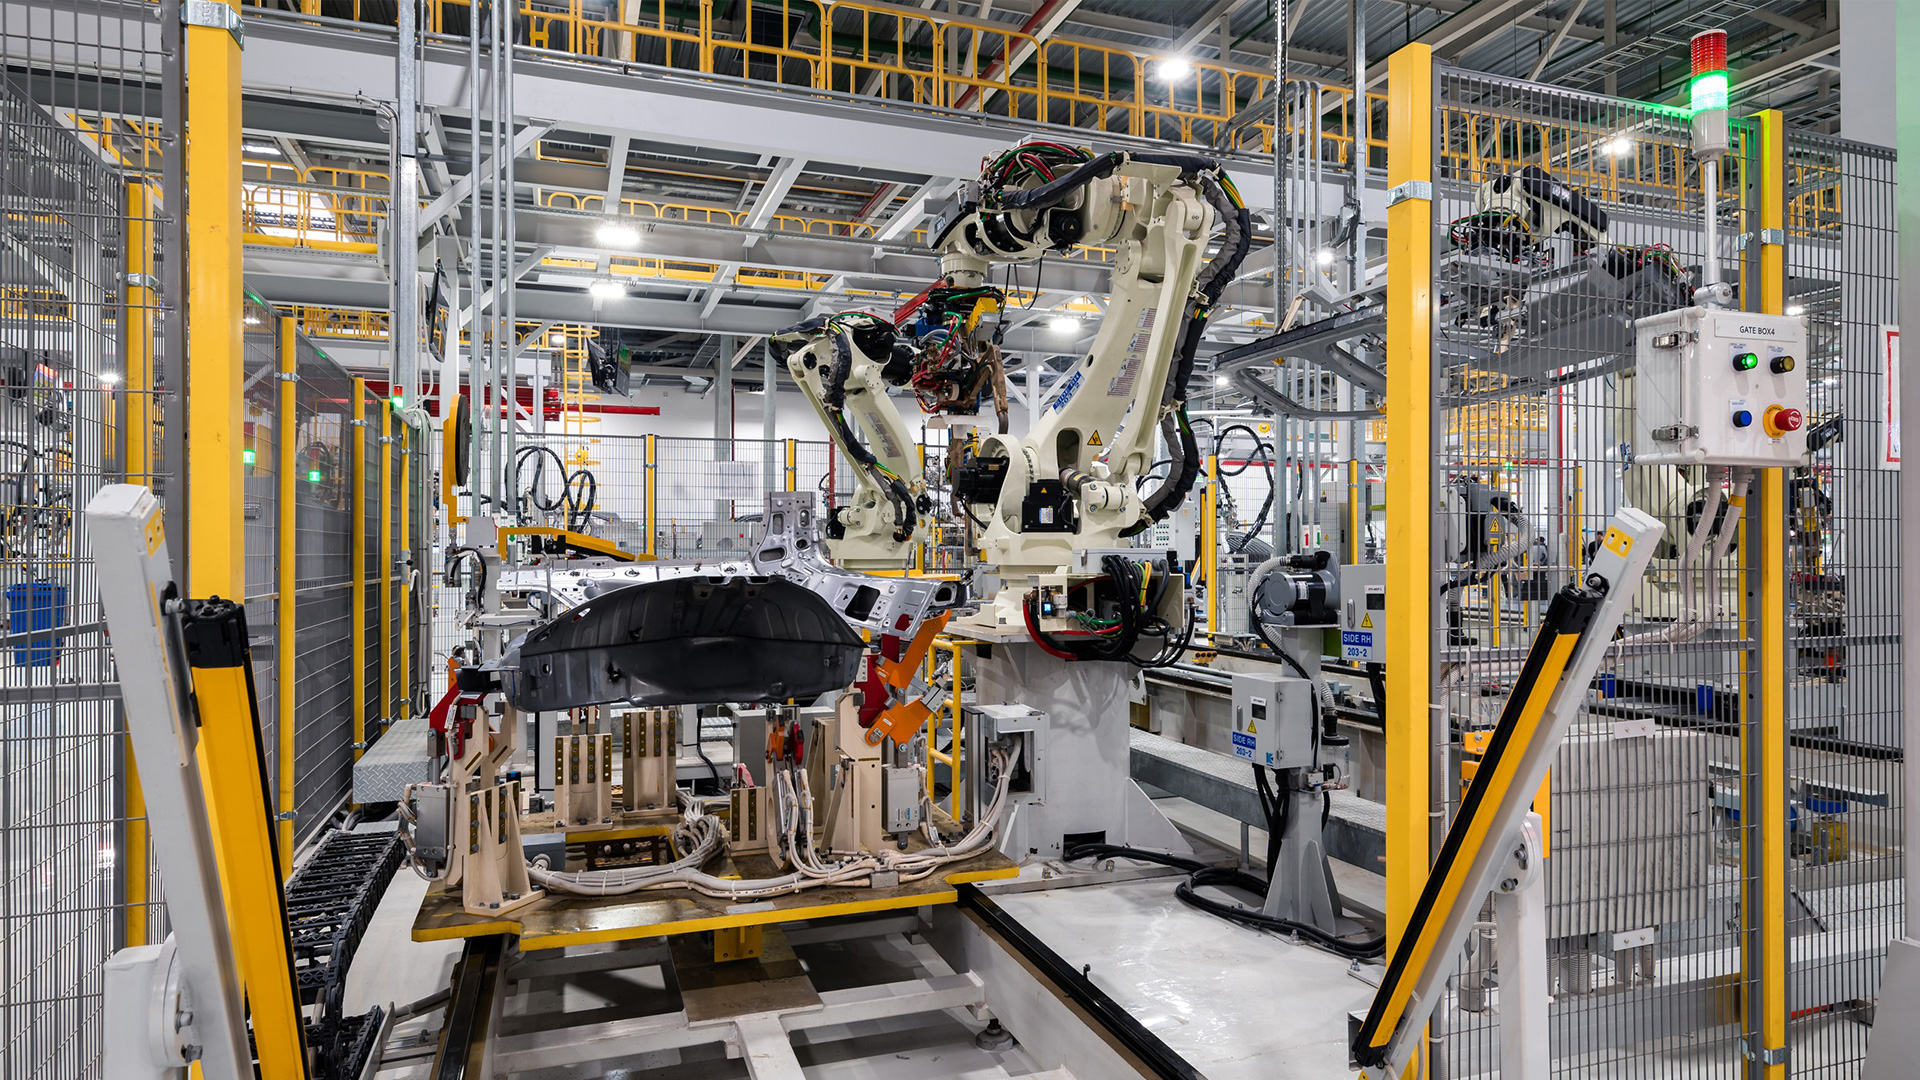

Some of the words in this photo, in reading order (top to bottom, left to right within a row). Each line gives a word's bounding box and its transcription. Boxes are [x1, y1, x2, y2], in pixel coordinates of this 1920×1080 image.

[1739, 325, 1756, 334] GATE
[1757, 327, 1775, 336] BOX4
[1060, 382, 1081, 408] 203-2
[1343, 634, 1360, 642] SIDE
[1361, 635, 1371, 643] RH
[1348, 648, 1367, 657] 203-2
[1233, 734, 1246, 744] SIDE
[1247, 738, 1255, 746] RH
[1236, 747, 1252, 758] 203-2
